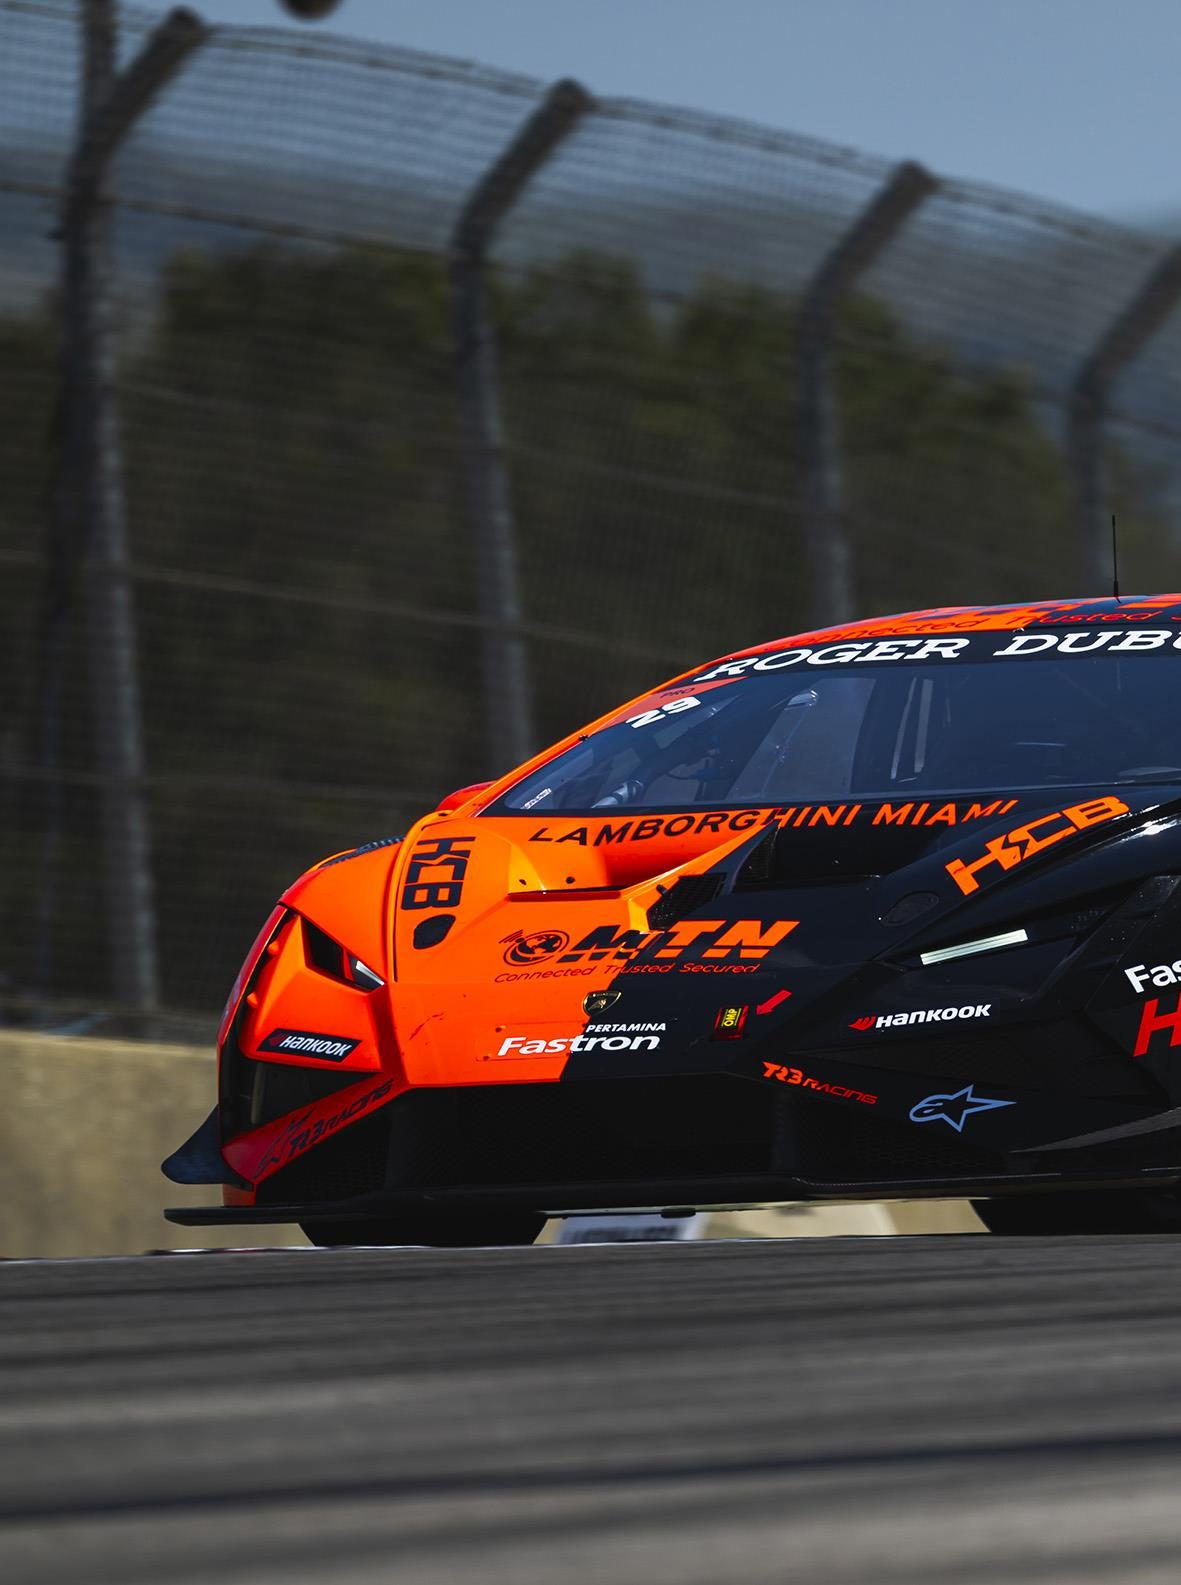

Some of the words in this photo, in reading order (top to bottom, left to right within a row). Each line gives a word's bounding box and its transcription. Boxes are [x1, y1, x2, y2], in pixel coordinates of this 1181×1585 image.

[693, 638, 970, 682] ROGER
[625, 696, 702, 729] 29
[528, 804, 863, 847] LAMBORGHINI
[871, 800, 1019, 827] MIAMI
[944, 796, 1131, 896] HCB
[401, 836, 477, 910] HCB
[556, 920, 801, 963] MTN
[494, 966, 596, 984] Connected
[603, 962, 675, 975] Trusted
[679, 962, 761, 974] Secured
[497, 1034, 661, 1057] Fastron
[585, 1022, 666, 1033] PERTAMINA
[803, 1078, 878, 1105] RACING
